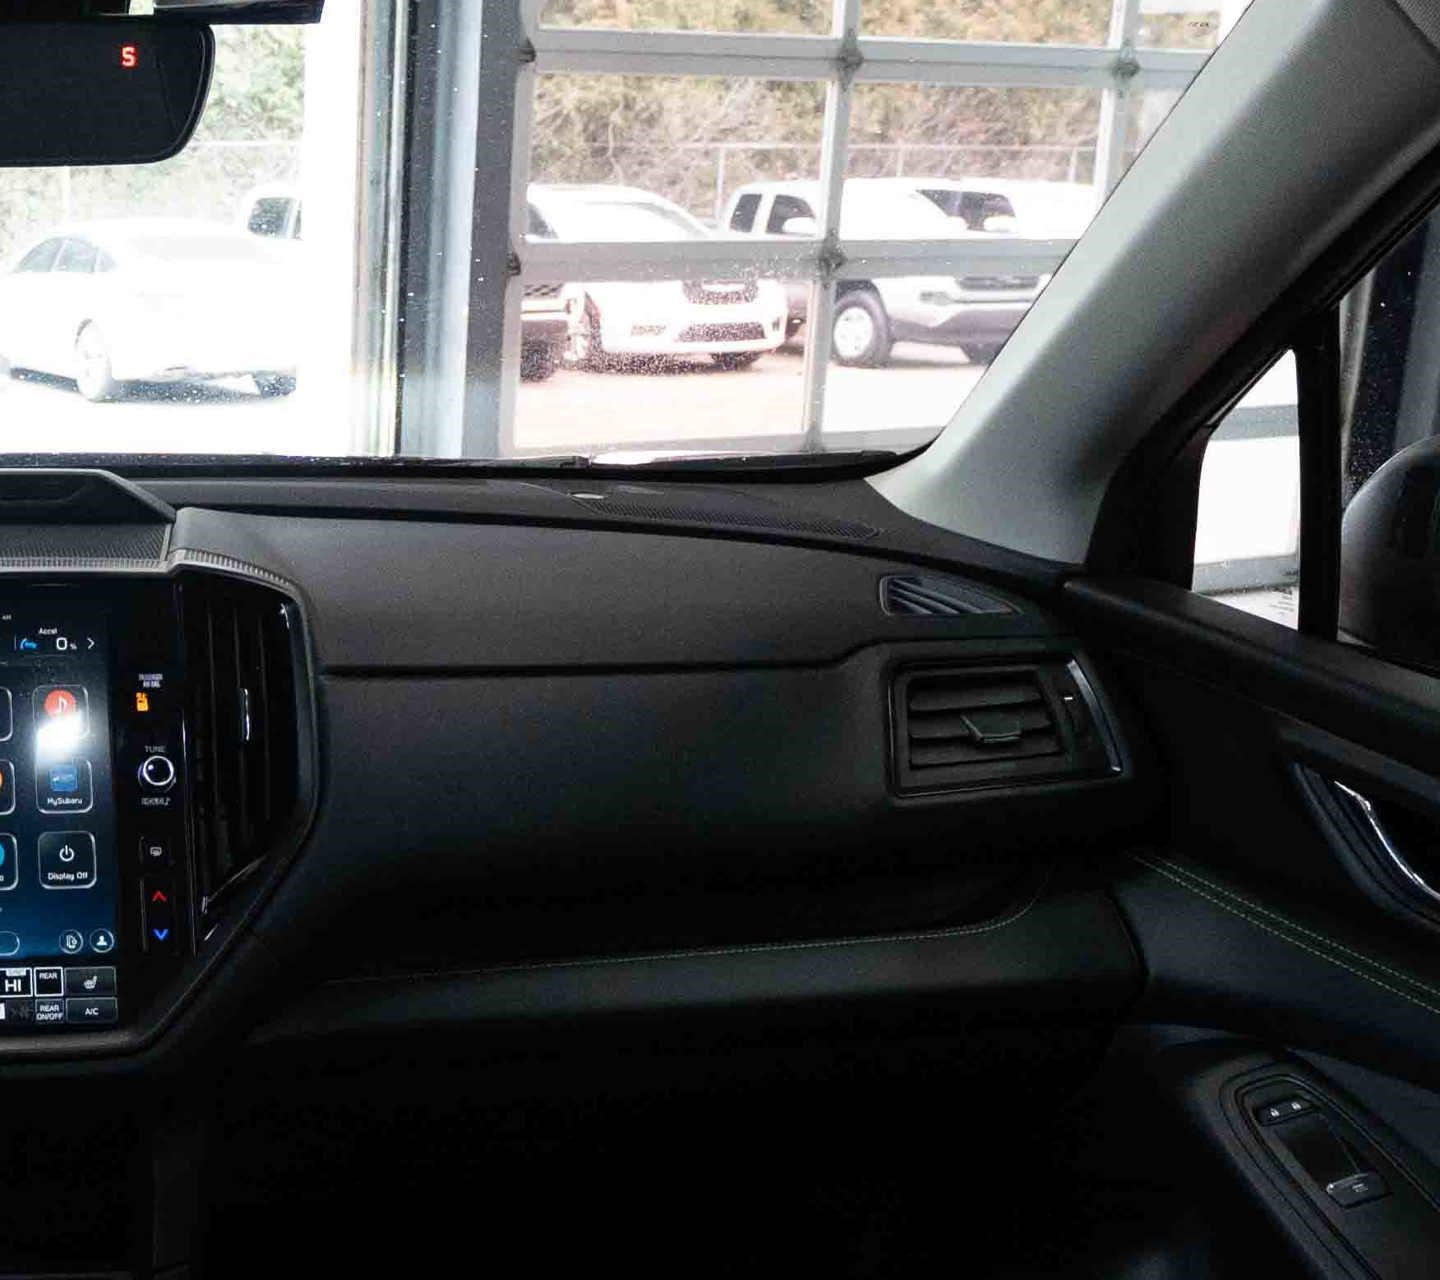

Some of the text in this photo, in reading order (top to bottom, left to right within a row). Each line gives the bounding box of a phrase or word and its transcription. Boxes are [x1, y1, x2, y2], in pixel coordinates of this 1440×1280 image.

[121, 46, 136, 67] S
[56, 637, 68, 651] 0
[144, 745, 167, 753] TUNE
[47, 796, 83, 806] MySubaru
[47, 871, 88, 881] Display Off
[39, 972, 58, 980] REAR
[4, 979, 22, 992] HI
[39, 1004, 60, 1012] REAR
[84, 1007, 99, 1016] A/C
